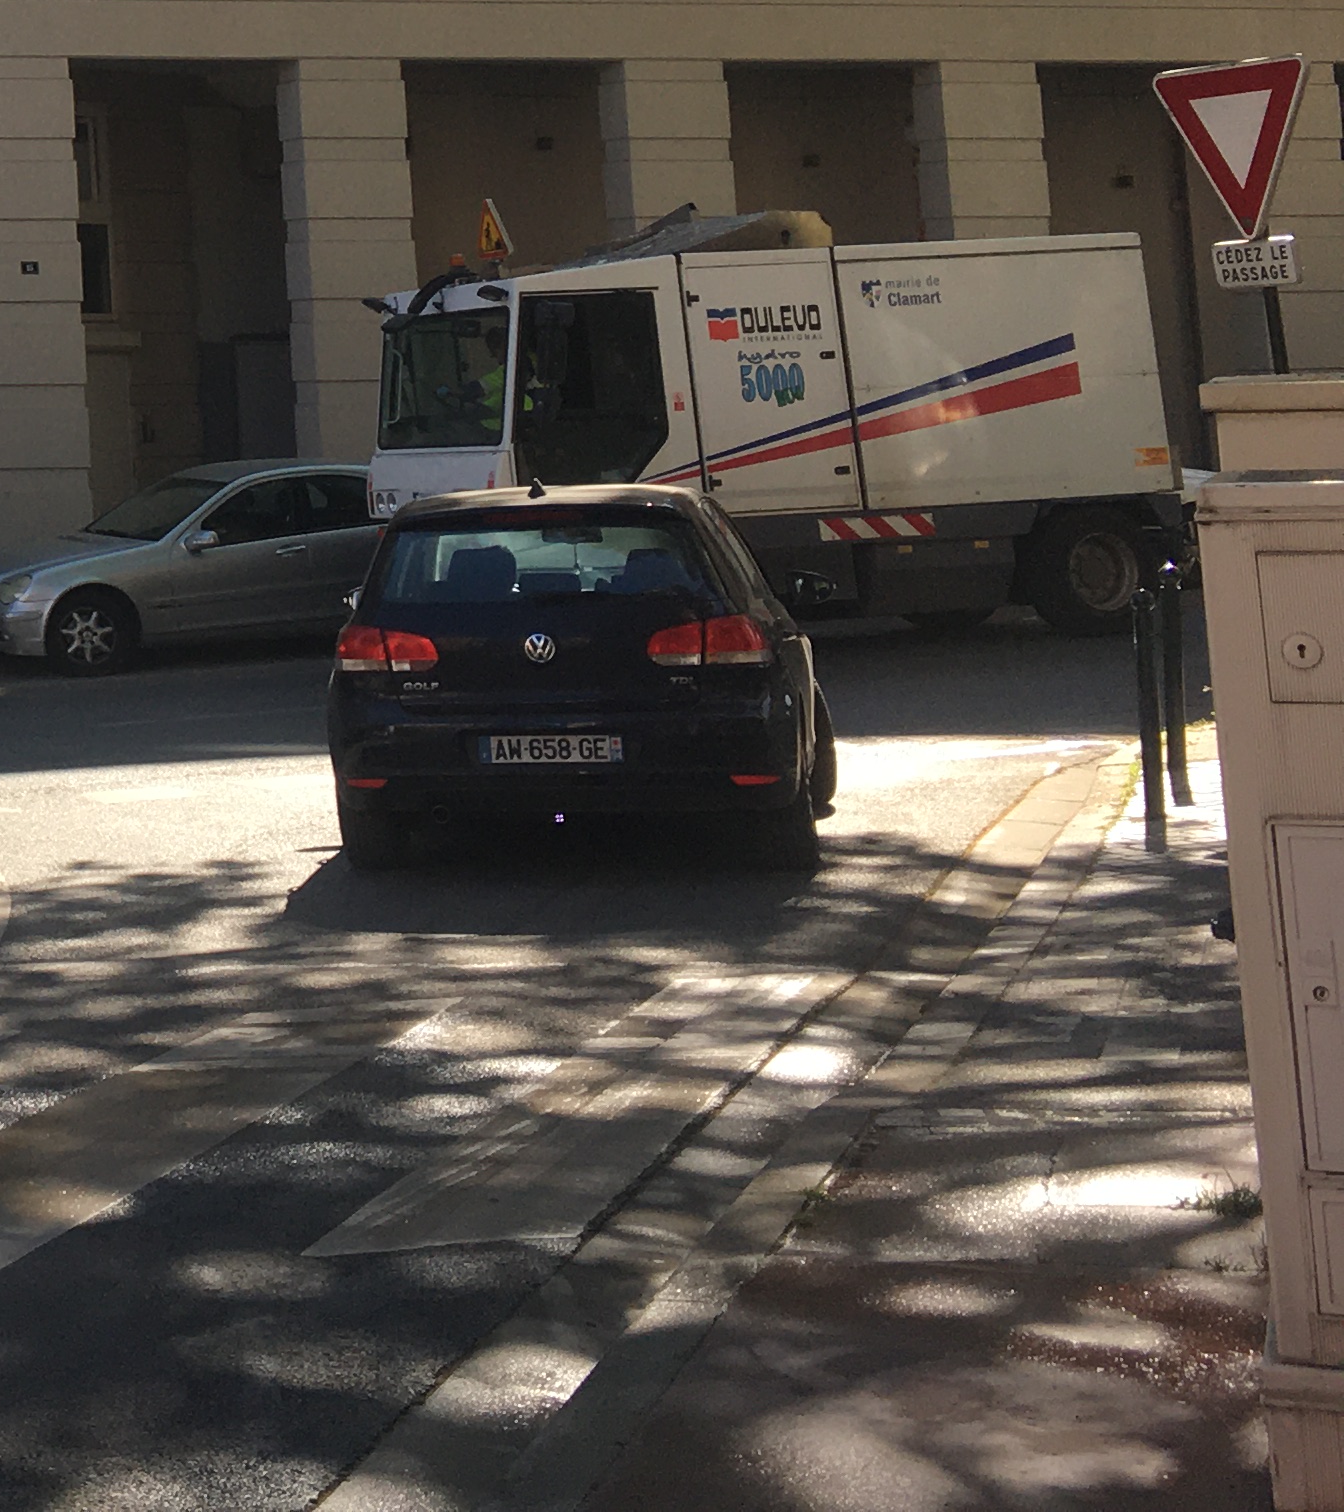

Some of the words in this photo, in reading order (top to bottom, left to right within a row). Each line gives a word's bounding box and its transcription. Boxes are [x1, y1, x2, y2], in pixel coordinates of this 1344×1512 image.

[1216, 243, 1263, 266] CÉDEZ
[1270, 244, 1289, 261] LE
[884, 275, 922, 289] mairie
[926, 274, 941, 287] de
[1222, 263, 1290, 283] PASSAGE
[887, 290, 943, 307] Clamart
[740, 304, 822, 334] DULEVO
[742, 333, 824, 343] INTERNATIONAL
[737, 349, 801, 365] hydro
[739, 362, 805, 403] 5000
[403, 681, 440, 691] GOLF
[494, 738, 609, 761] AW-658-GE
